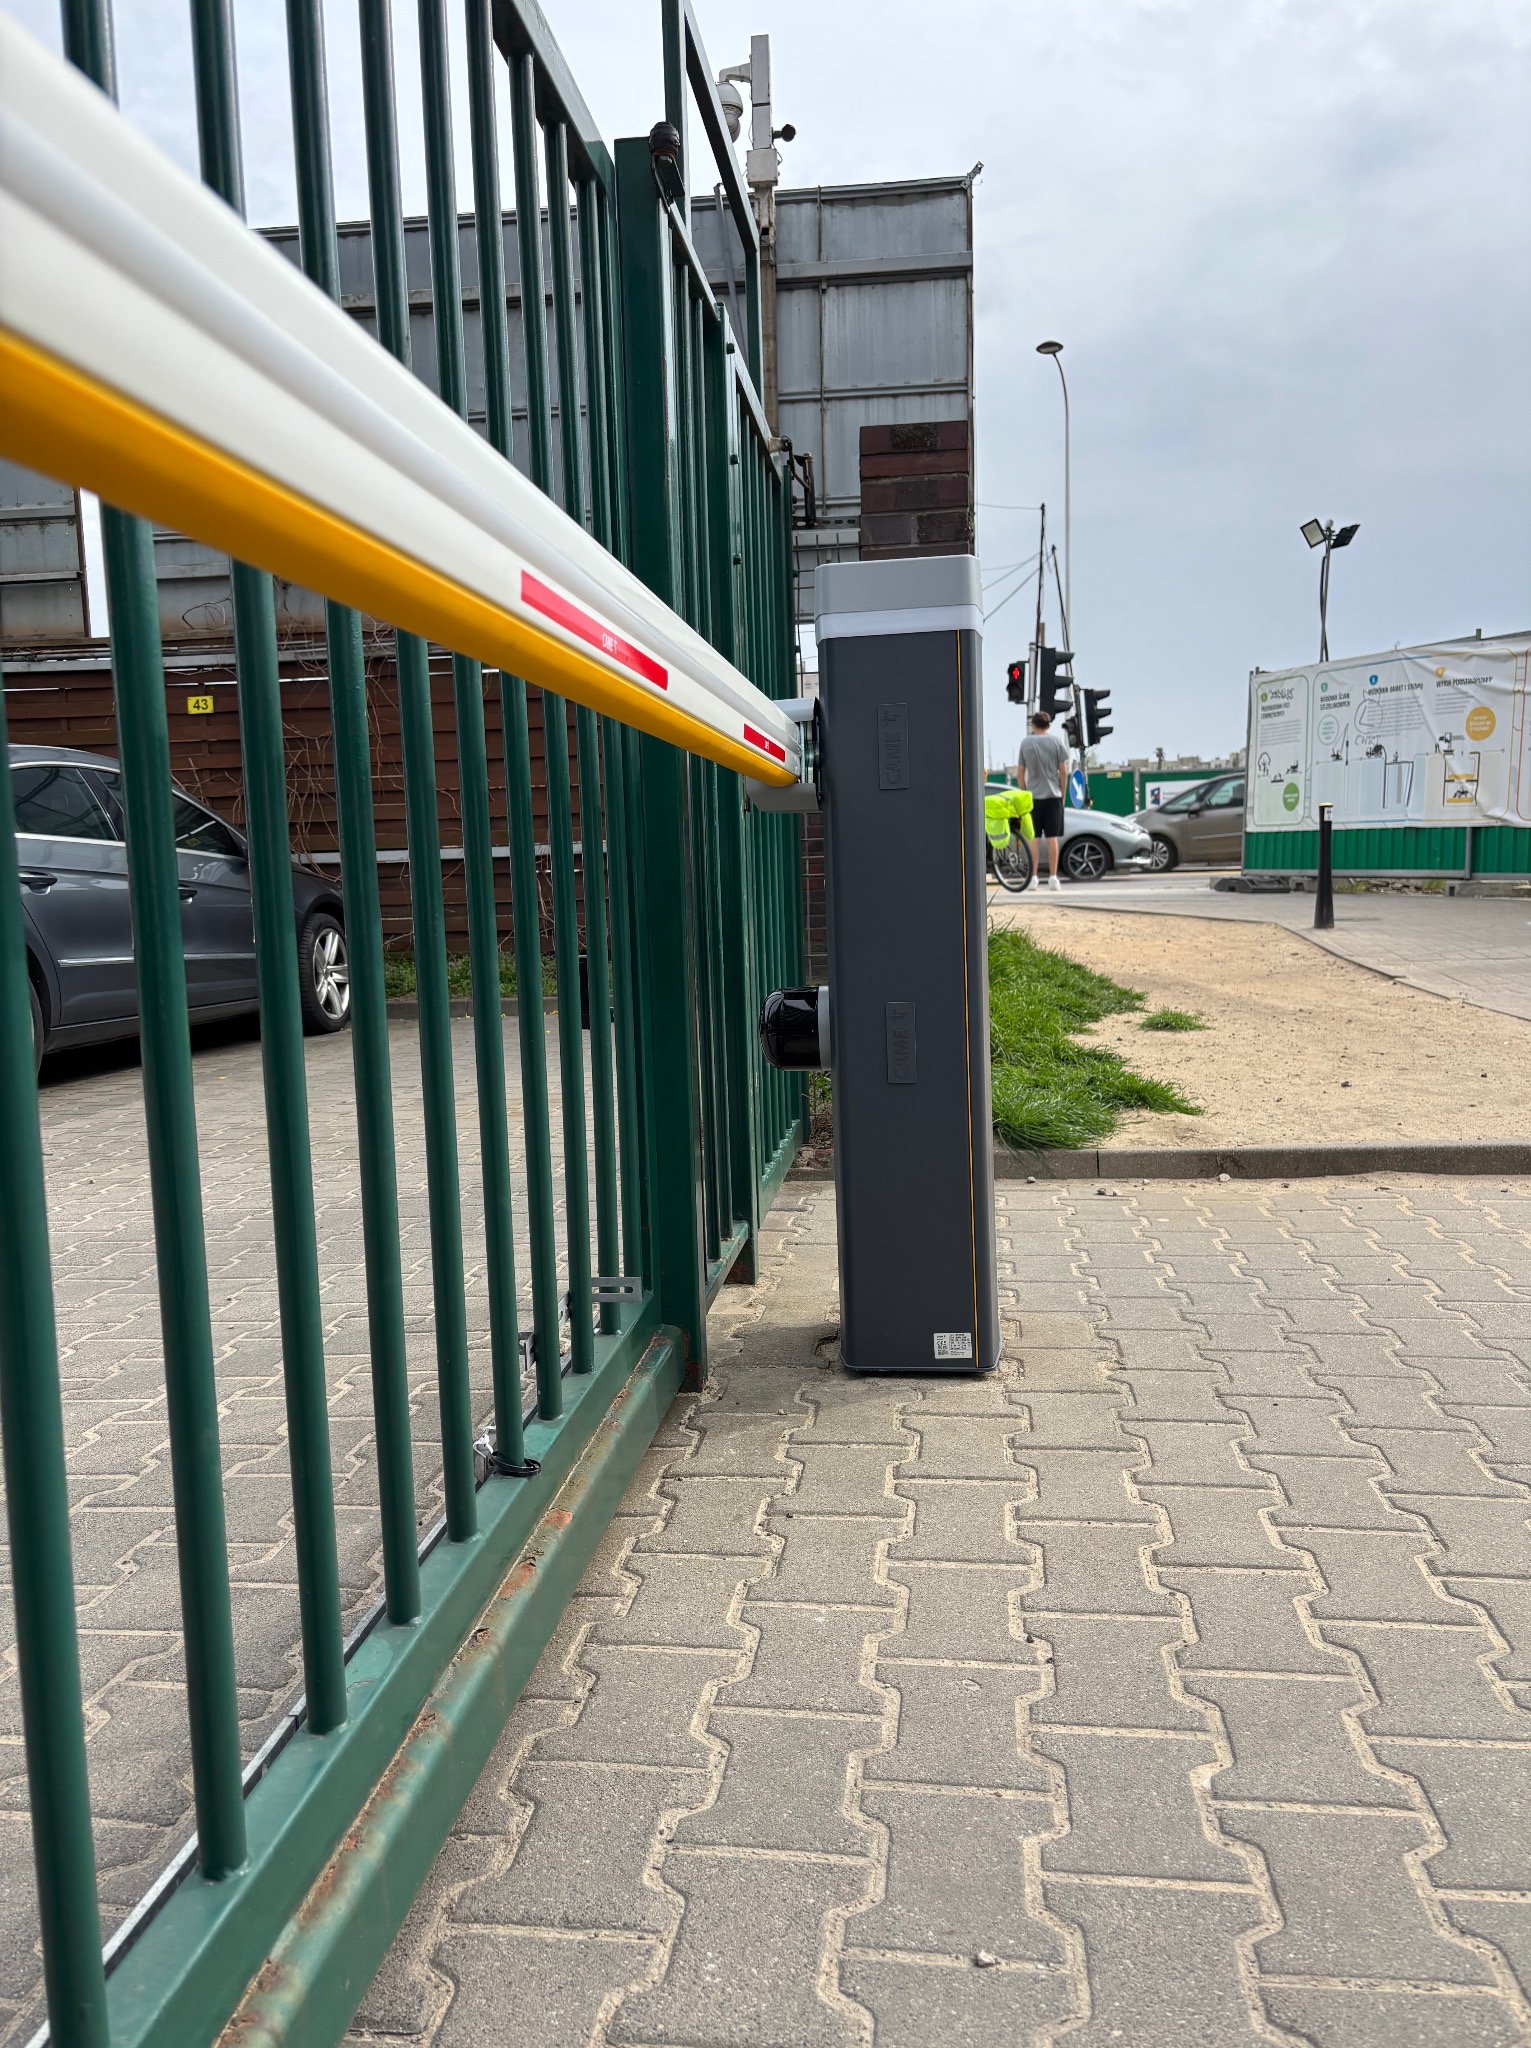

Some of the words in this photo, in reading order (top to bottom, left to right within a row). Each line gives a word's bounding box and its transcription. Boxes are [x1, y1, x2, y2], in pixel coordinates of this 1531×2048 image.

[193, 699, 208, 711] 43
[884, 732, 901, 784] CAME
[893, 1030, 910, 1080] CAME
